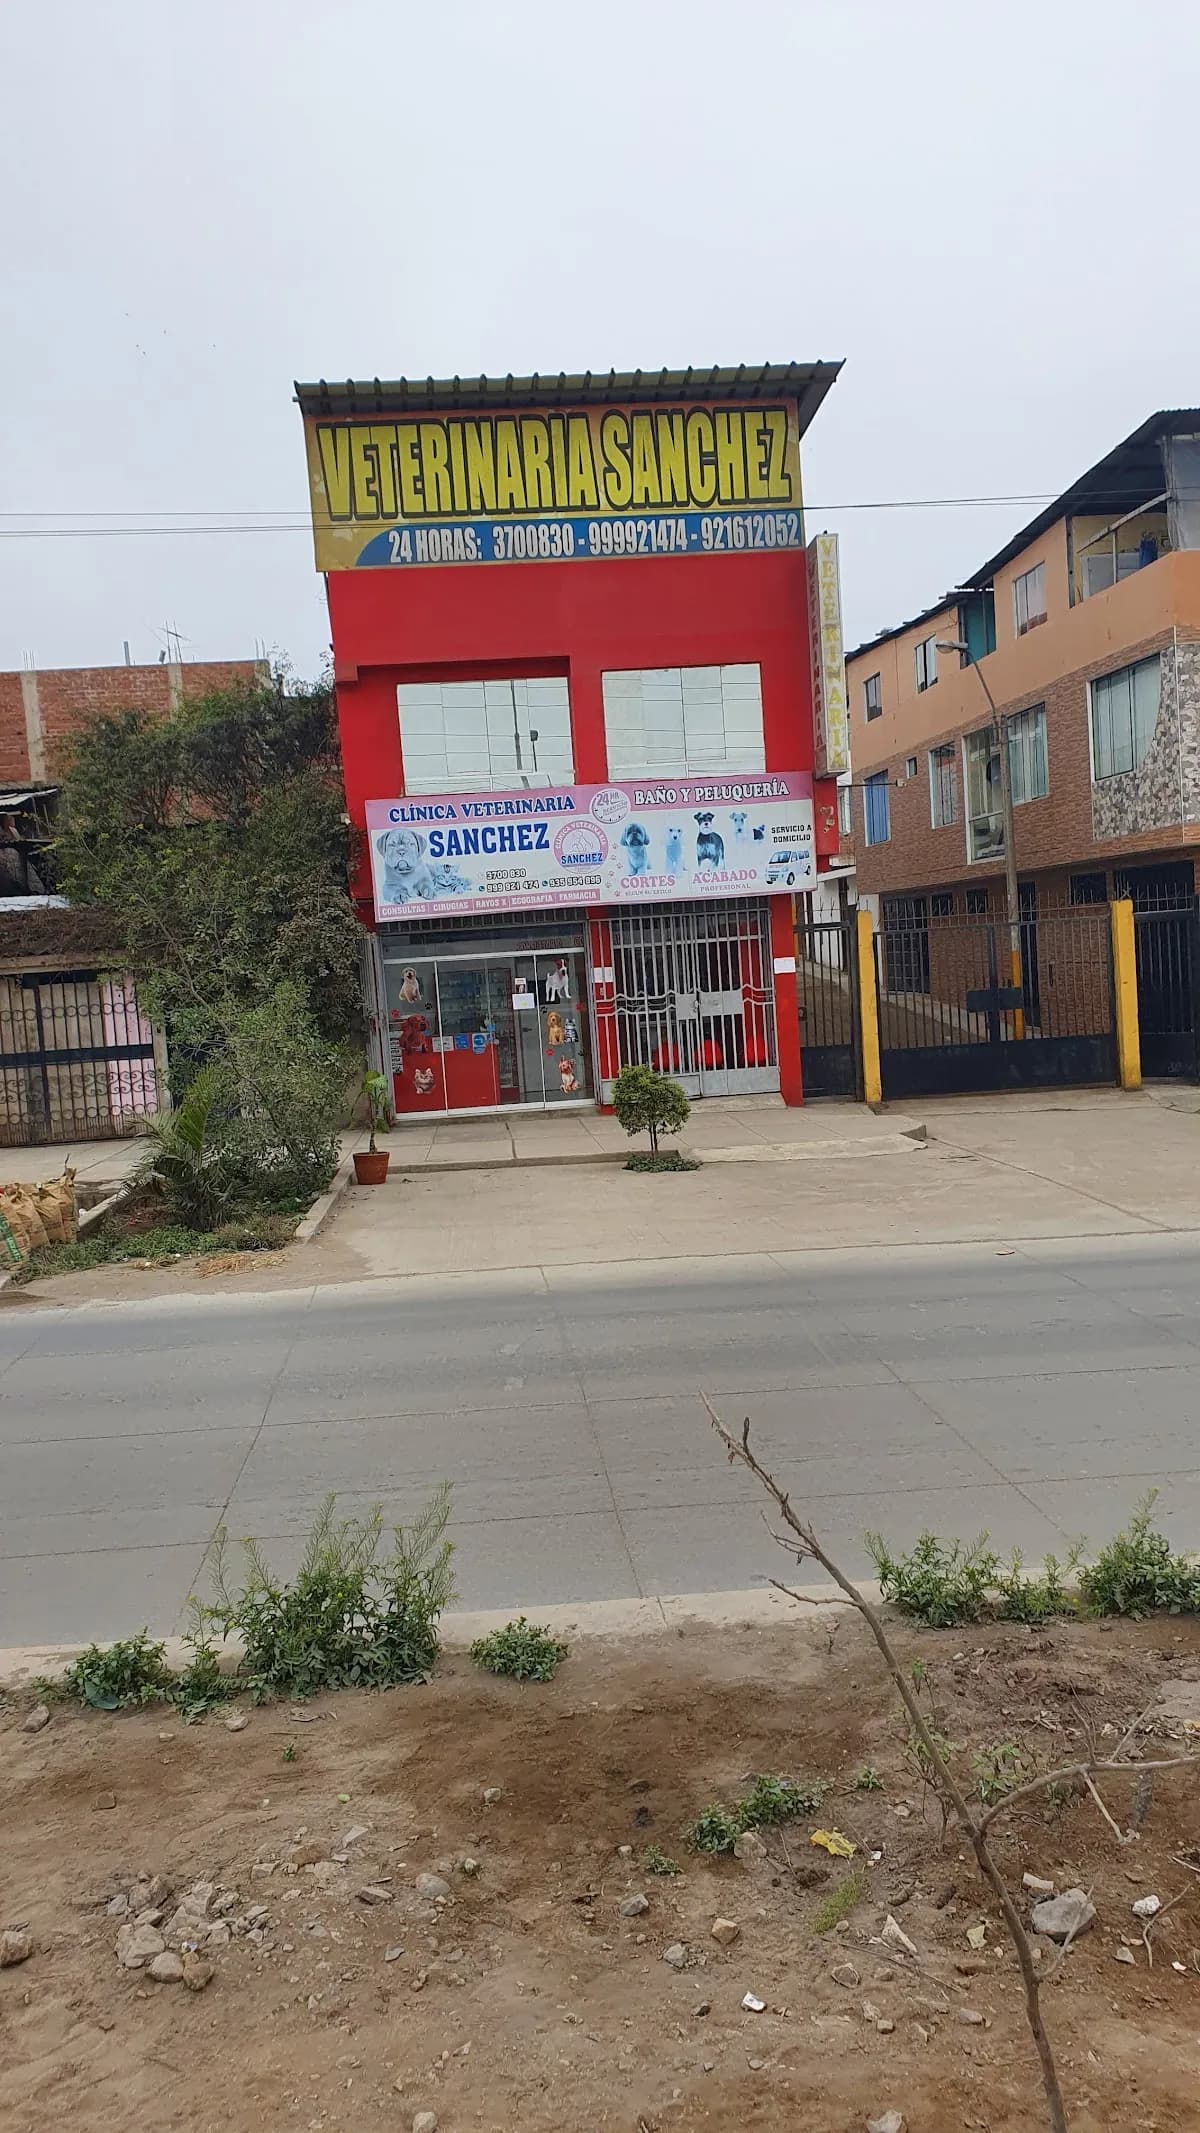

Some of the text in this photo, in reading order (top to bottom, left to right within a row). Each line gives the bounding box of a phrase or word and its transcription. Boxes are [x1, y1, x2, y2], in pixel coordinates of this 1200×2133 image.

[317, 405, 792, 520] VETERINARIA SANCHEZ
[388, 529, 412, 563] 24
[416, 525, 483, 562] HORAS:
[493, 521, 575, 559] 3700830
[589, 518, 687, 555] 999921474
[701, 512, 799, 550] 921612052
[634, 777, 790, 806] BAÑO Y PELUQUERÍA
[597, 793, 610, 806] 24
[389, 795, 576, 823] CLÍNICA VETERINARIA
[771, 824, 805, 834] SERVICIO
[429, 823, 550, 857] SANCHEZ
[773, 834, 811, 843] DOMICILIO
[561, 852, 603, 865] SANCHEZ
[486, 868, 526, 880] 3700 830
[692, 868, 758, 884] ACABADO
[487, 883, 503, 892] 999
[620, 874, 676, 889] CORTES
[700, 883, 751, 892] PROFESIONAL
[512, 894, 553, 905] ECOGRAFIA
[560, 891, 597, 901] FARMACIA
[476, 899, 500, 908] RAYOS
[382, 904, 426, 916] CONSULTAS
